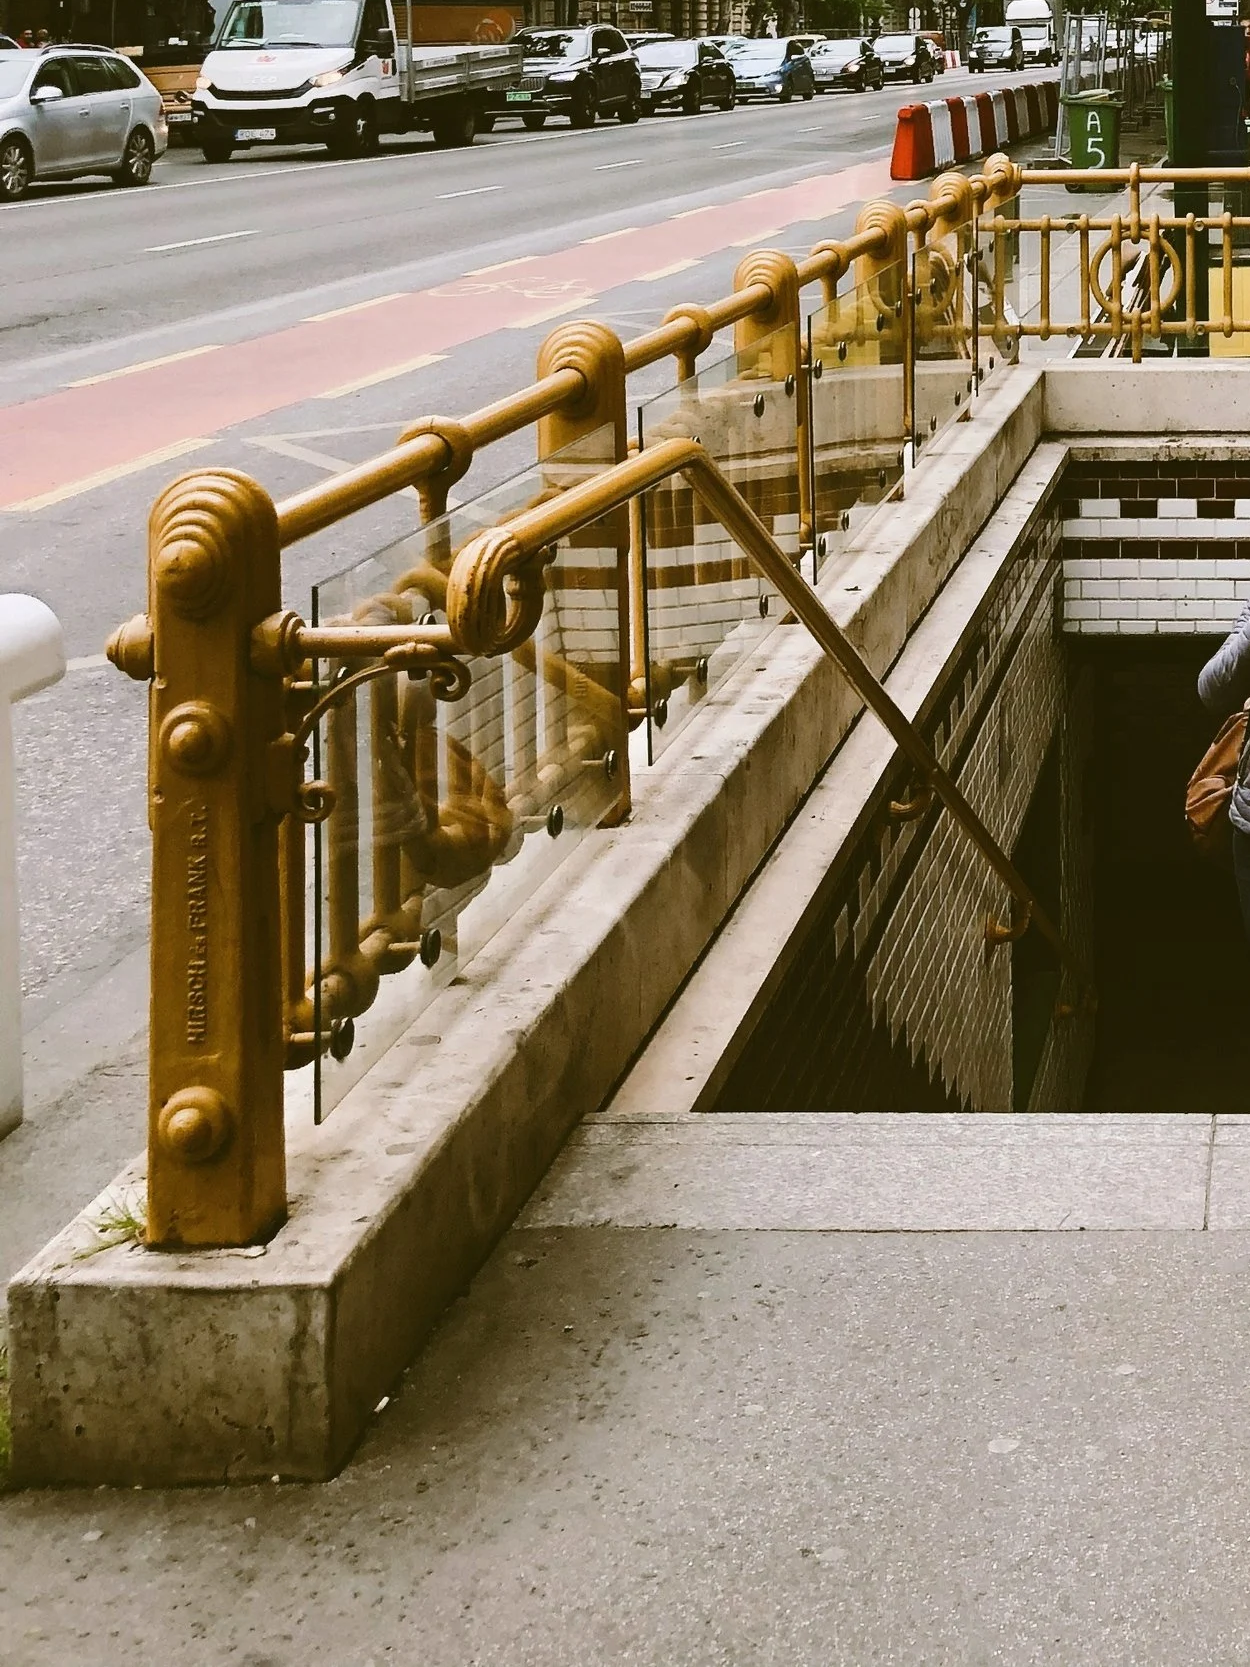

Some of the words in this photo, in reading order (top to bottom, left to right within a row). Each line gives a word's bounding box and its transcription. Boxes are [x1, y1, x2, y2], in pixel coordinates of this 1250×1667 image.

[1086, 111, 1101, 133] A
[1086, 137, 1106, 169] 5
[187, 854, 208, 930] FRANK
[187, 960, 208, 1046] HIRSCH
